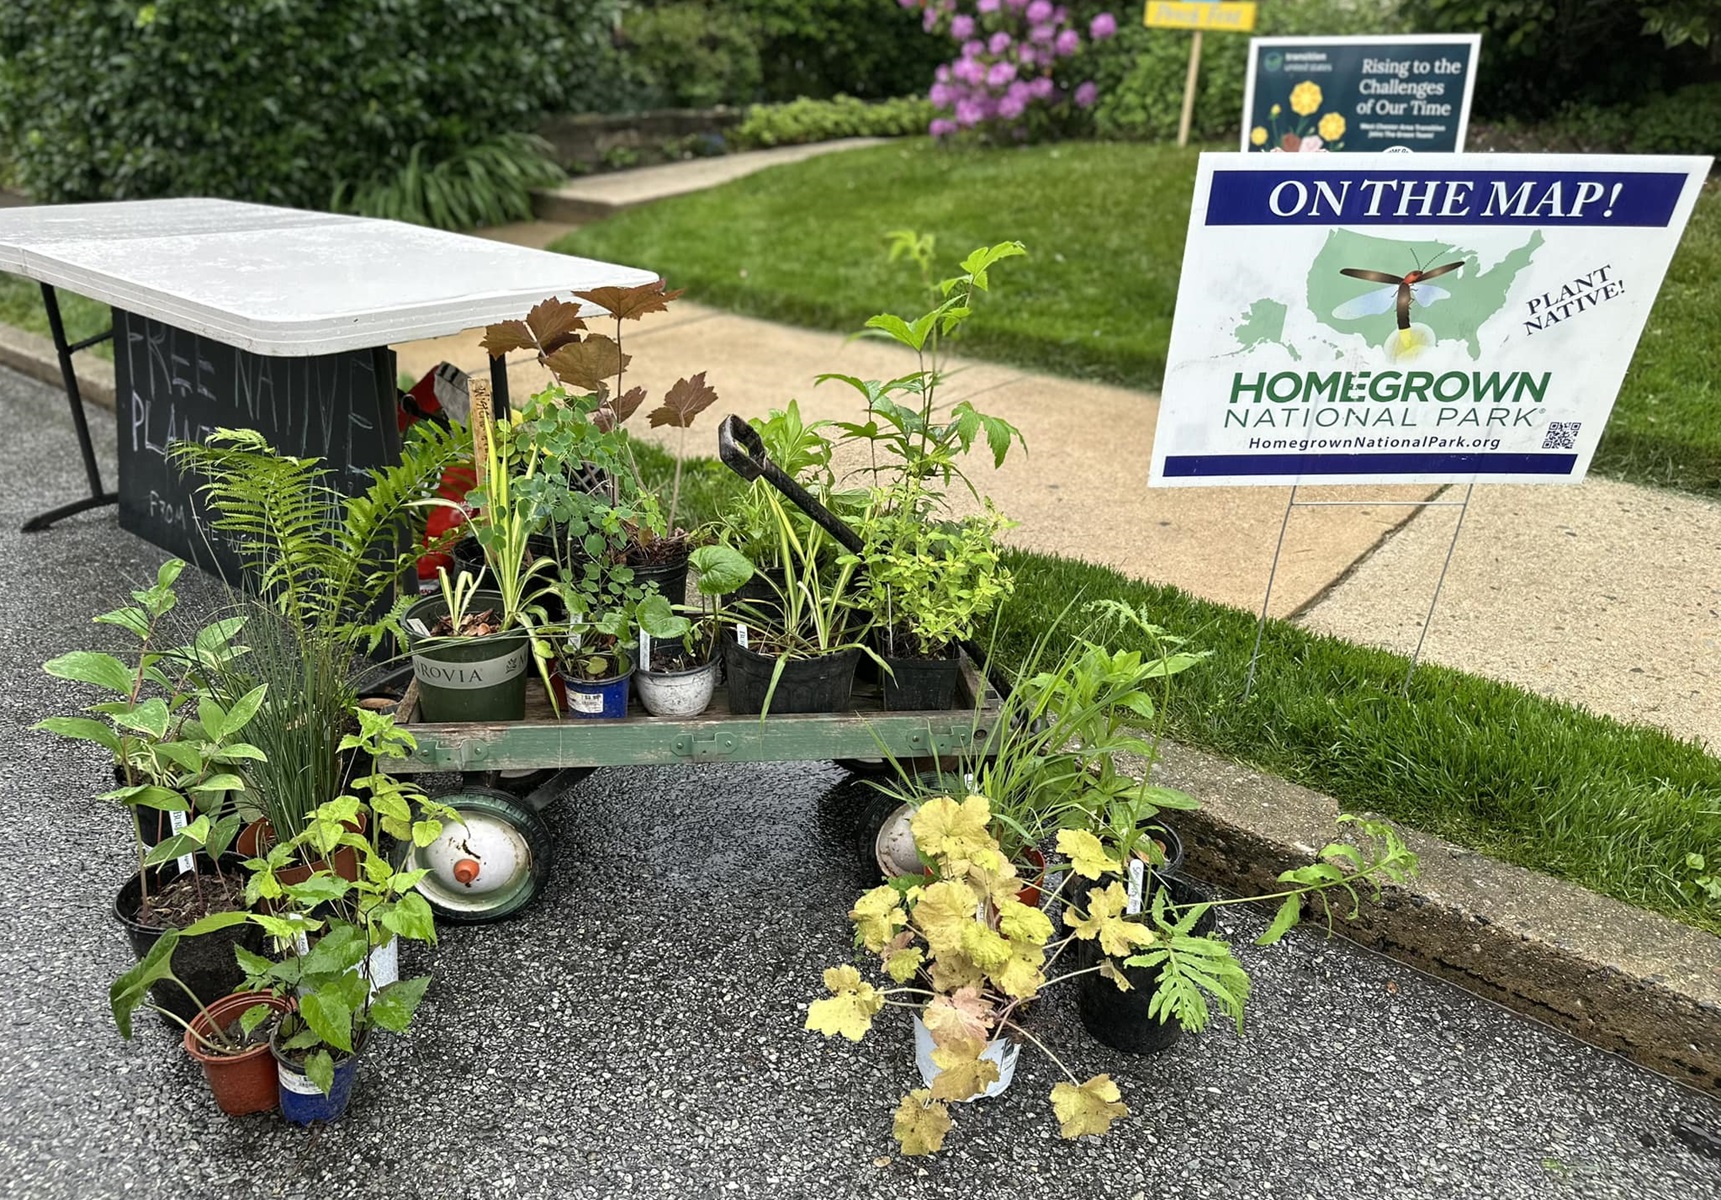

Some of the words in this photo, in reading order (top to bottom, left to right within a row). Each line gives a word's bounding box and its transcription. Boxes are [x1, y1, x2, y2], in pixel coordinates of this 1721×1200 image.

[1362, 58, 1410, 78] Rising
[1413, 61, 1430, 74] to
[1434, 58, 1462, 74] the
[1359, 79, 1445, 99] Challenges
[1356, 99, 1375, 115] of
[1375, 100, 1408, 115] Our
[1410, 101, 1452, 116] Time
[1268, 180, 1352, 217] ON
[1359, 179, 1475, 217] THE
[1480, 181, 1624, 218] MAP!
[1526, 264, 1612, 316] PLANT
[1523, 280, 1626, 337] NATIVE!
[1229, 371, 1552, 404] HOMEGROWN
[1224, 407, 1417, 428] NATIONAL
[1249, 436, 1501, 451] HomegrownNationalPark.org
